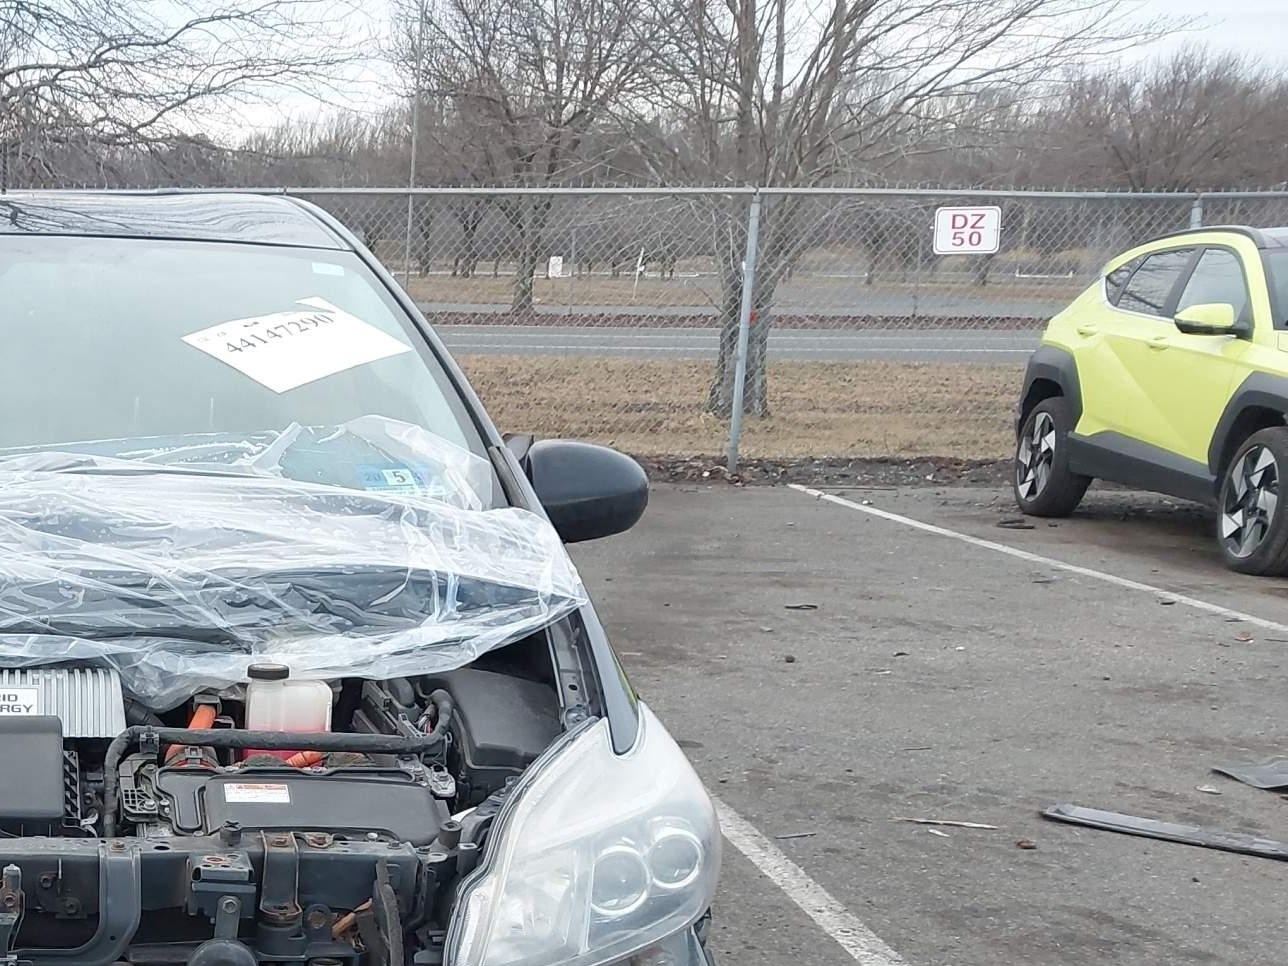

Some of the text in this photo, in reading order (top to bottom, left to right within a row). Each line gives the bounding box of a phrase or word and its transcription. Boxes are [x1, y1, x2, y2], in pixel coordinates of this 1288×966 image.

[951, 213, 986, 230] DZ
[951, 231, 982, 247] 50
[225, 313, 335, 353] 44147290
[391, 470, 407, 483] 5
